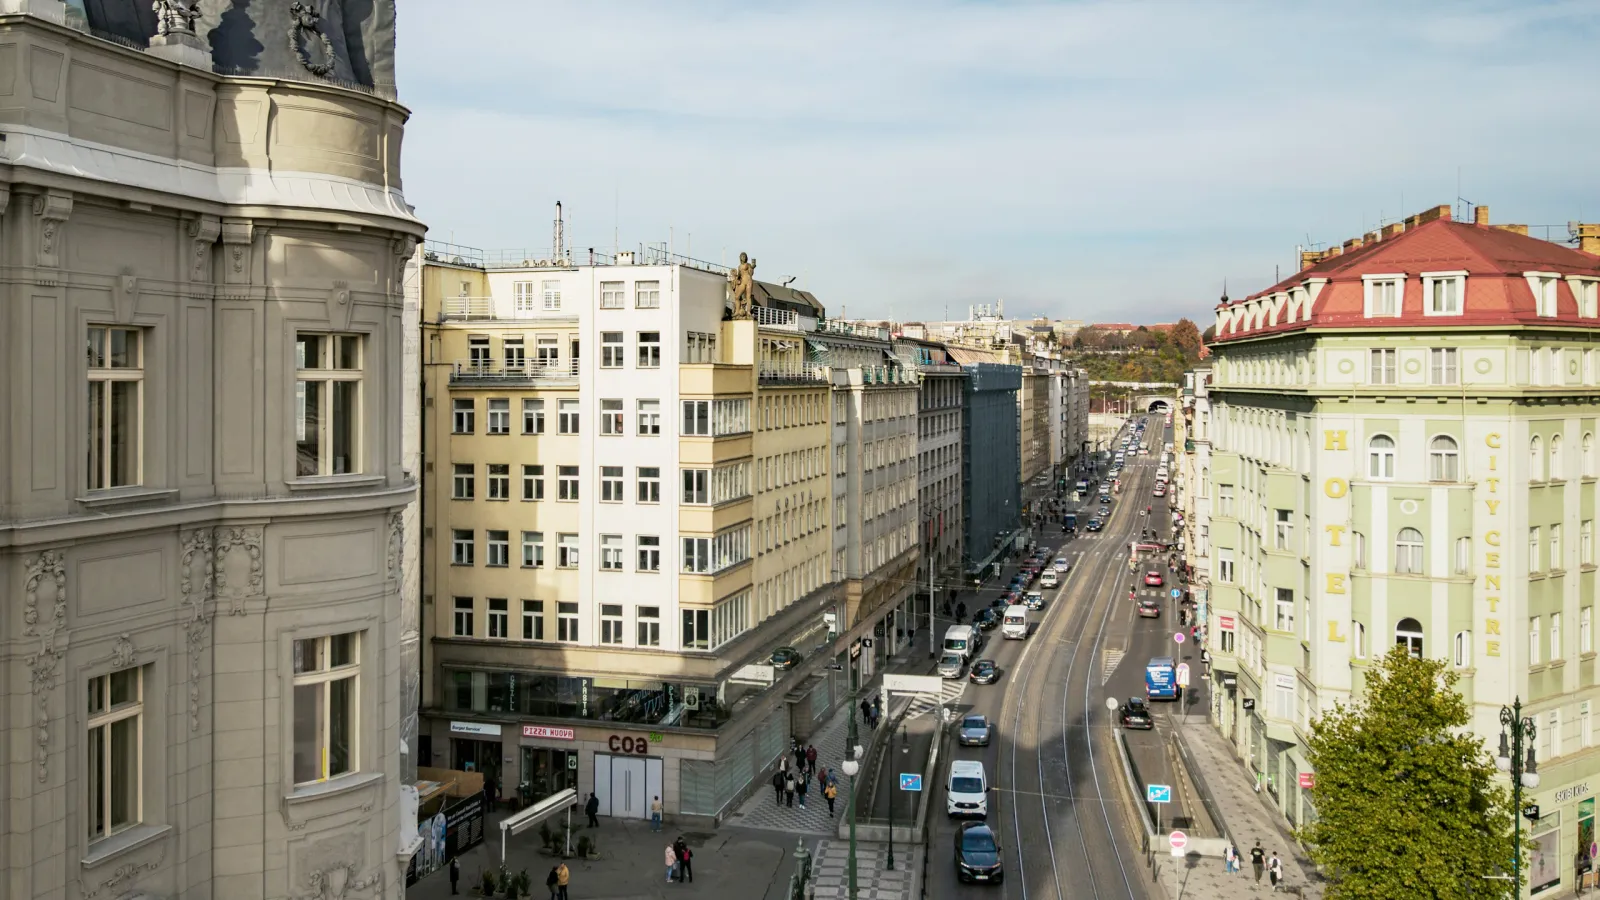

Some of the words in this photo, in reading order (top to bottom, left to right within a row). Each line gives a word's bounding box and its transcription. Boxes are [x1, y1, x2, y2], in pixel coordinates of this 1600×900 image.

[1485, 432, 1501, 516] CITY
[1324, 429, 1348, 642] HOTEL
[1485, 529, 1501, 658] CENTRE
[524, 727, 546, 735] PIZZA
[550, 729, 573, 738] NUOVA
[1576, 782, 1589, 796] KIDS
